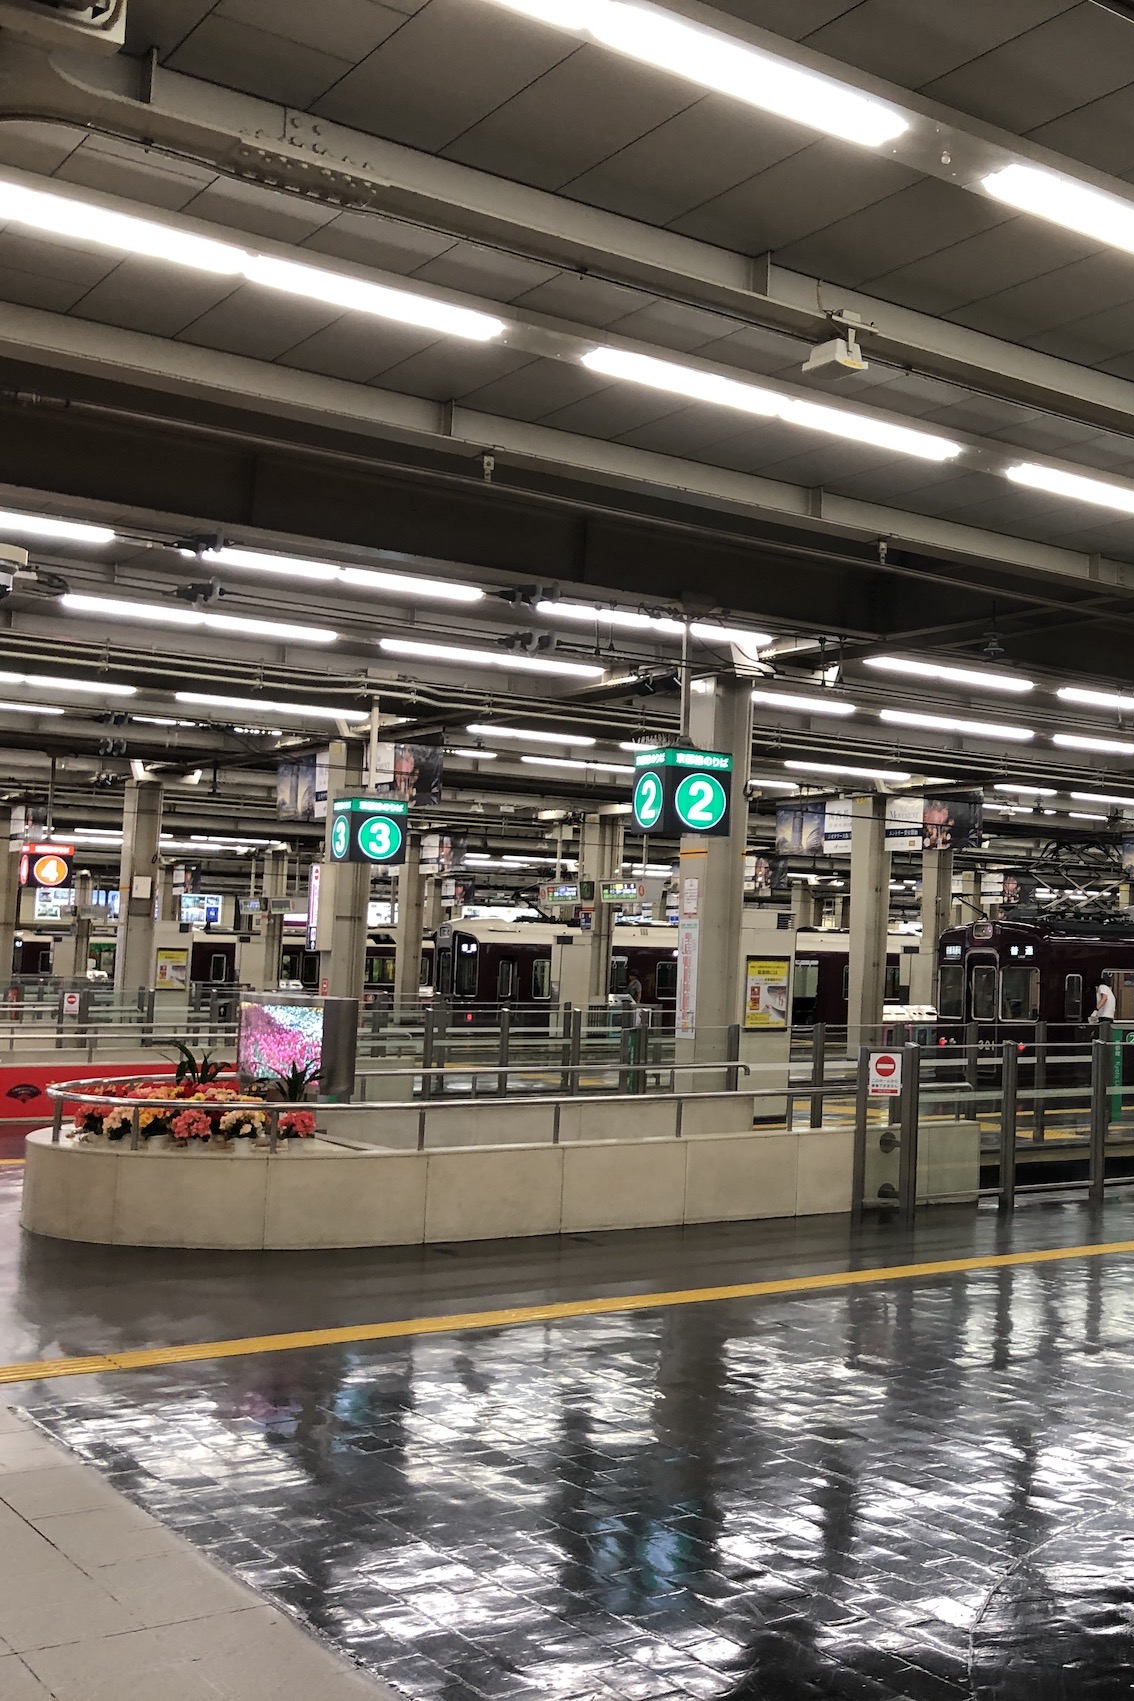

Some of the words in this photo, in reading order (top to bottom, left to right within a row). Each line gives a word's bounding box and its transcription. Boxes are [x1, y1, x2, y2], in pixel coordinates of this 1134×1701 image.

[640, 780, 656, 819] 2
[687, 781, 714, 821] 2
[335, 821, 345, 853] 3
[369, 822, 391, 854] 3
[41, 860, 59, 882] 4
